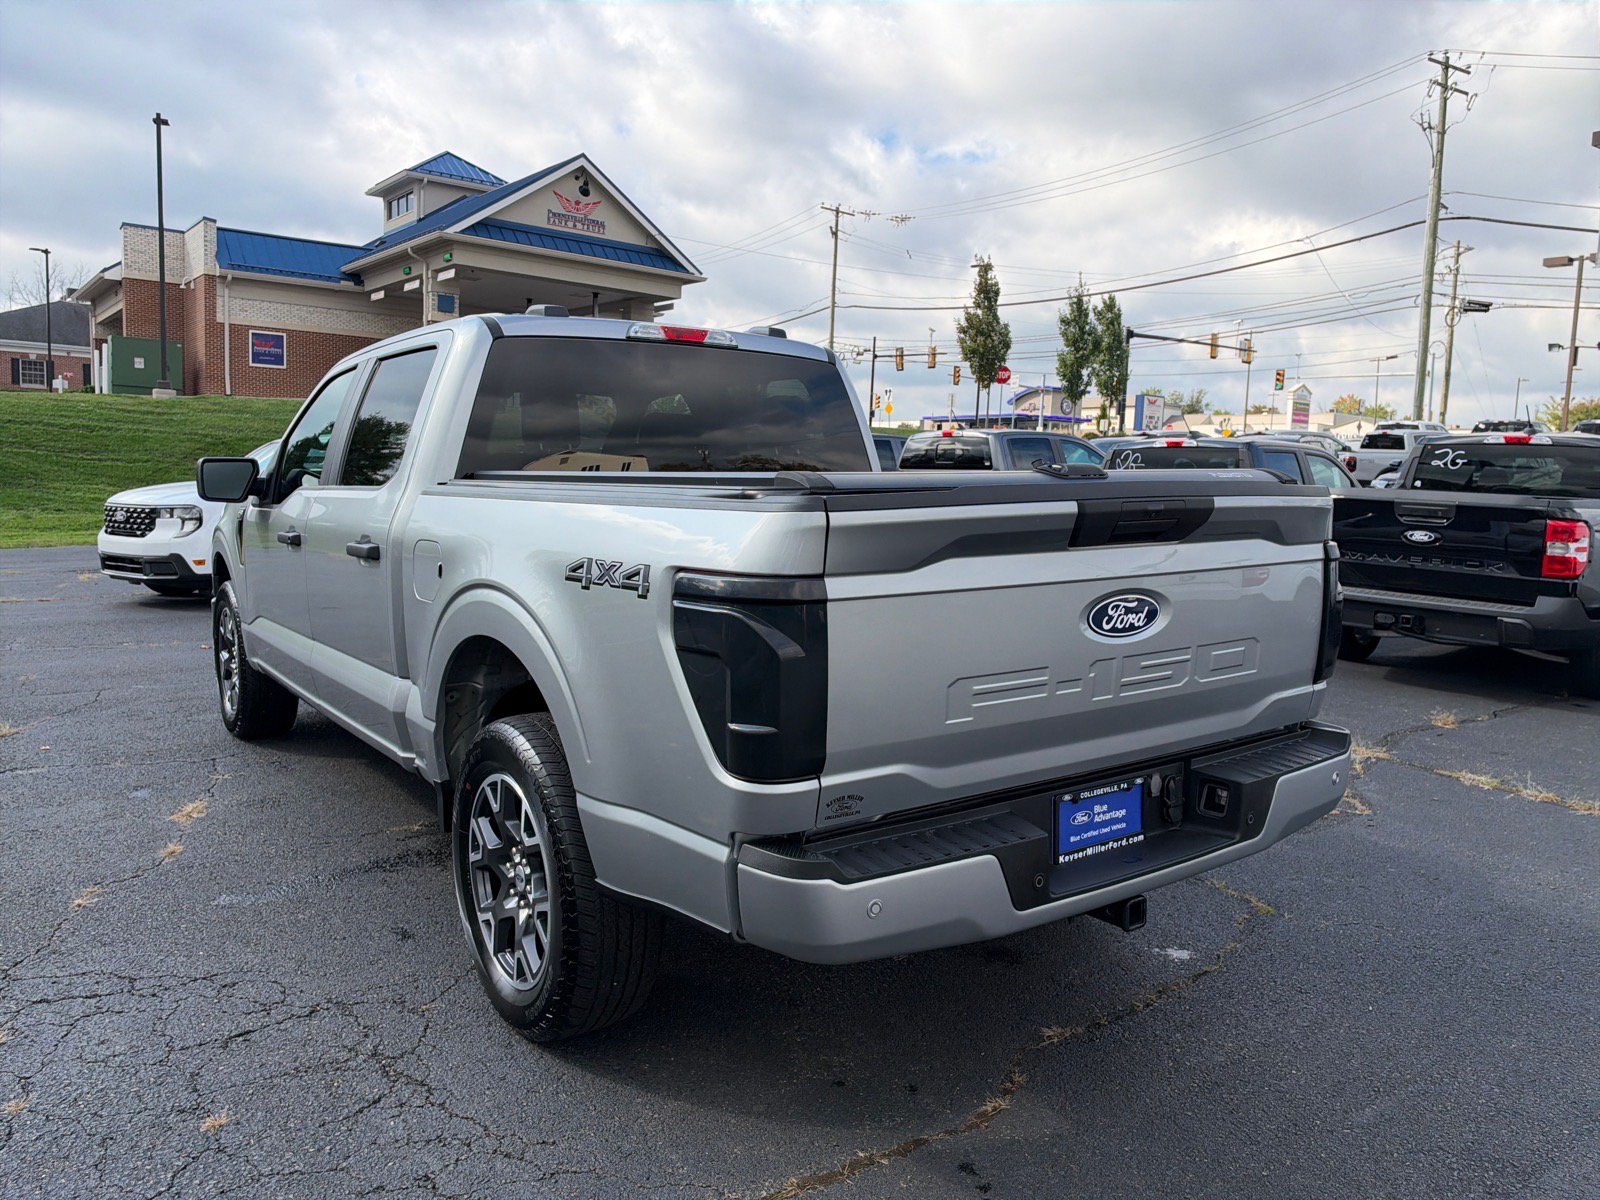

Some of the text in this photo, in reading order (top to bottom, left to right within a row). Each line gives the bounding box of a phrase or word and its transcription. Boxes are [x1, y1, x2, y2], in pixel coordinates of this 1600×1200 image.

[1344, 551, 1503, 574] MAVERICK
[1102, 600, 1149, 630] Ford
[945, 637, 1260, 724] F-150
[1093, 804, 1108, 814] Blue
[1094, 808, 1127, 823] Advantage
[1070, 822, 1127, 843] Blue Certified Used Vehicle
[1059, 834, 1145, 864] KeyserMillerFord.com
